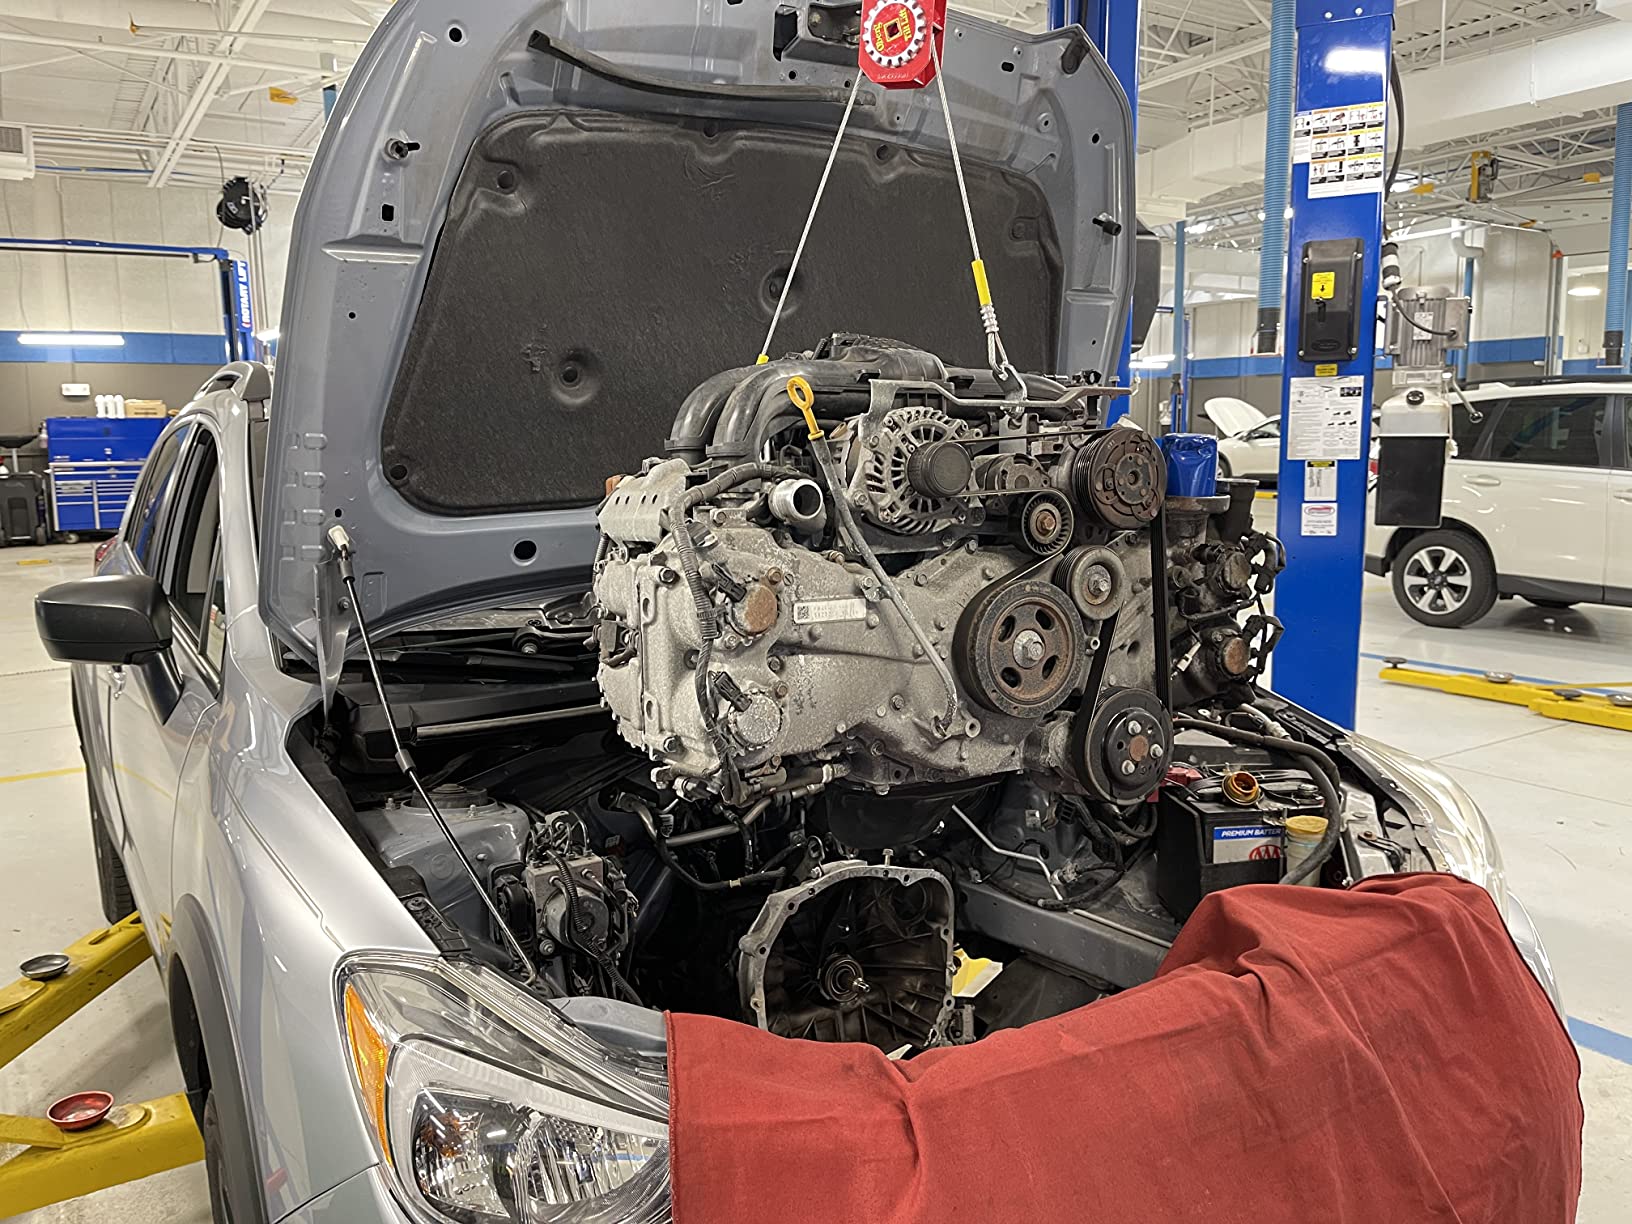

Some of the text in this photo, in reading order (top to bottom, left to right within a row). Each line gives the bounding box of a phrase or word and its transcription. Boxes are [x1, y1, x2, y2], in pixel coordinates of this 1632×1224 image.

[902, 25, 912, 42] Tilt
[237, 260, 251, 323] ROTARY LIFT
[1221, 828, 1282, 838] PREMIUM BATTER
